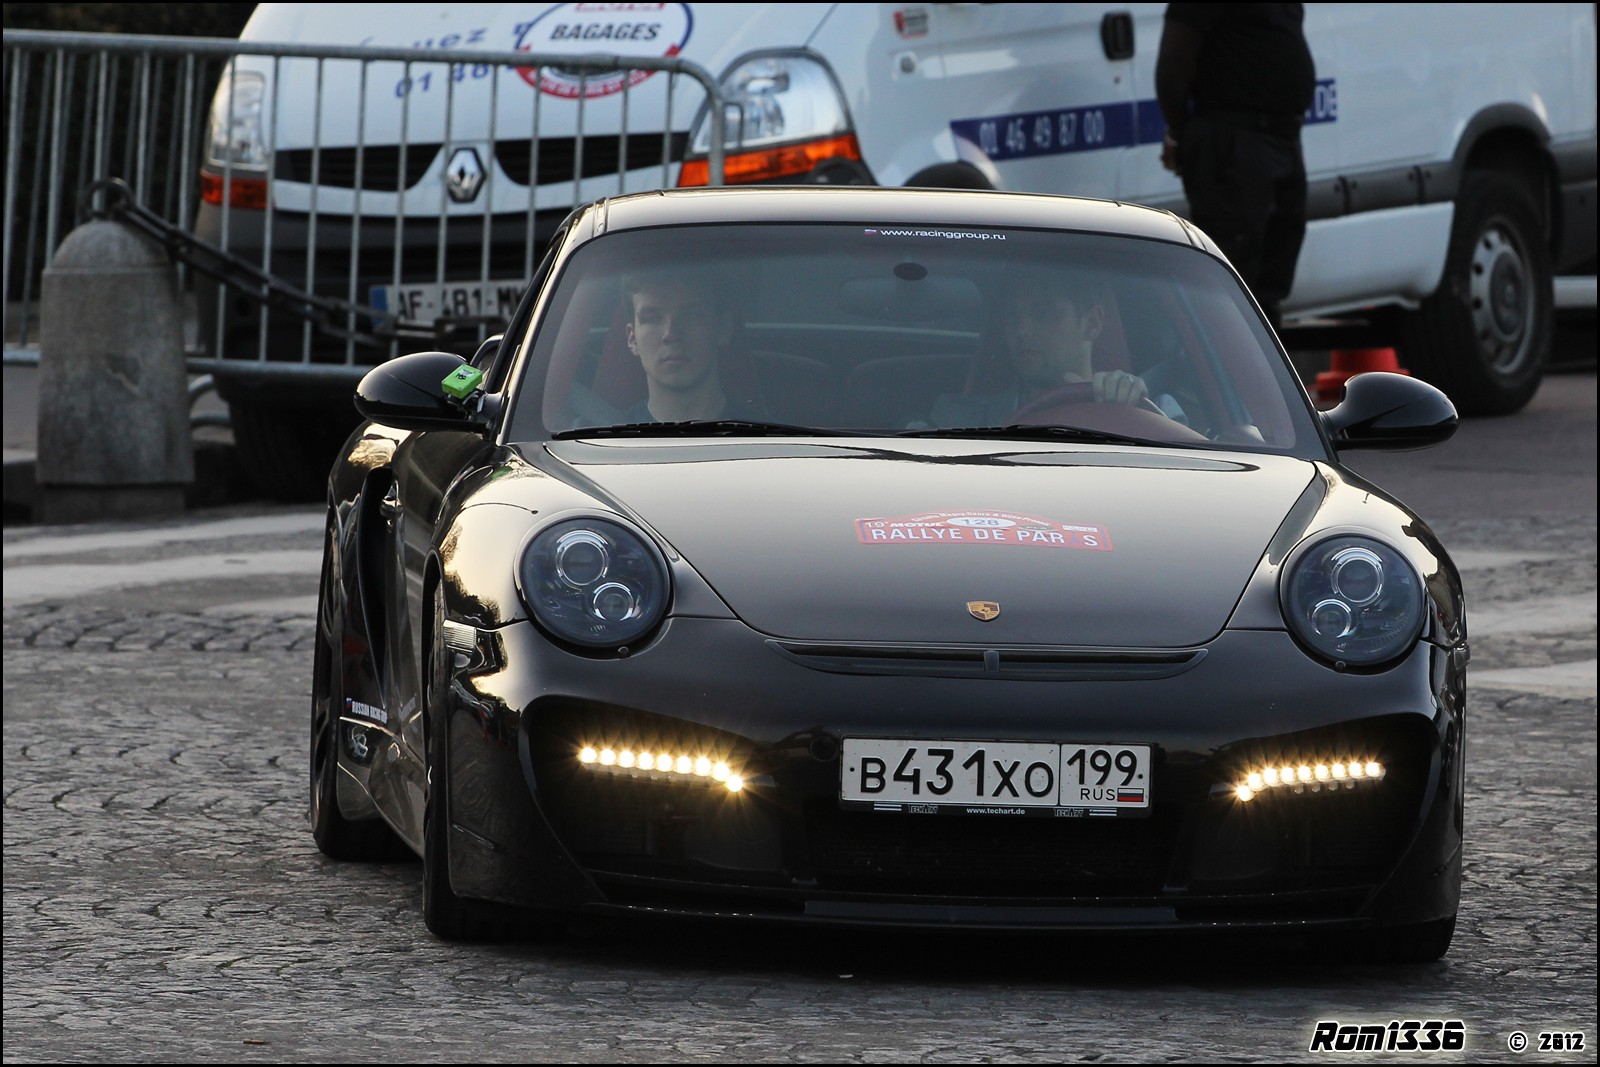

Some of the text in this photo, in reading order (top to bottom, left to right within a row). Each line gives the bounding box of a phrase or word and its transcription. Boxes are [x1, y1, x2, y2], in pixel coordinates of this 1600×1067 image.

[550, 23, 661, 40] BAGAGES
[879, 228, 1007, 242] www.racinggroup.ru
[890, 521, 944, 529] MOTUL
[961, 518, 1001, 527] 128
[871, 527, 962, 541] RALLYE
[973, 528, 1006, 541] DE
[1066, 748, 1138, 787] 199
[1080, 788, 1116, 801] RUS
[966, 805, 1026, 816] www.techart.de
